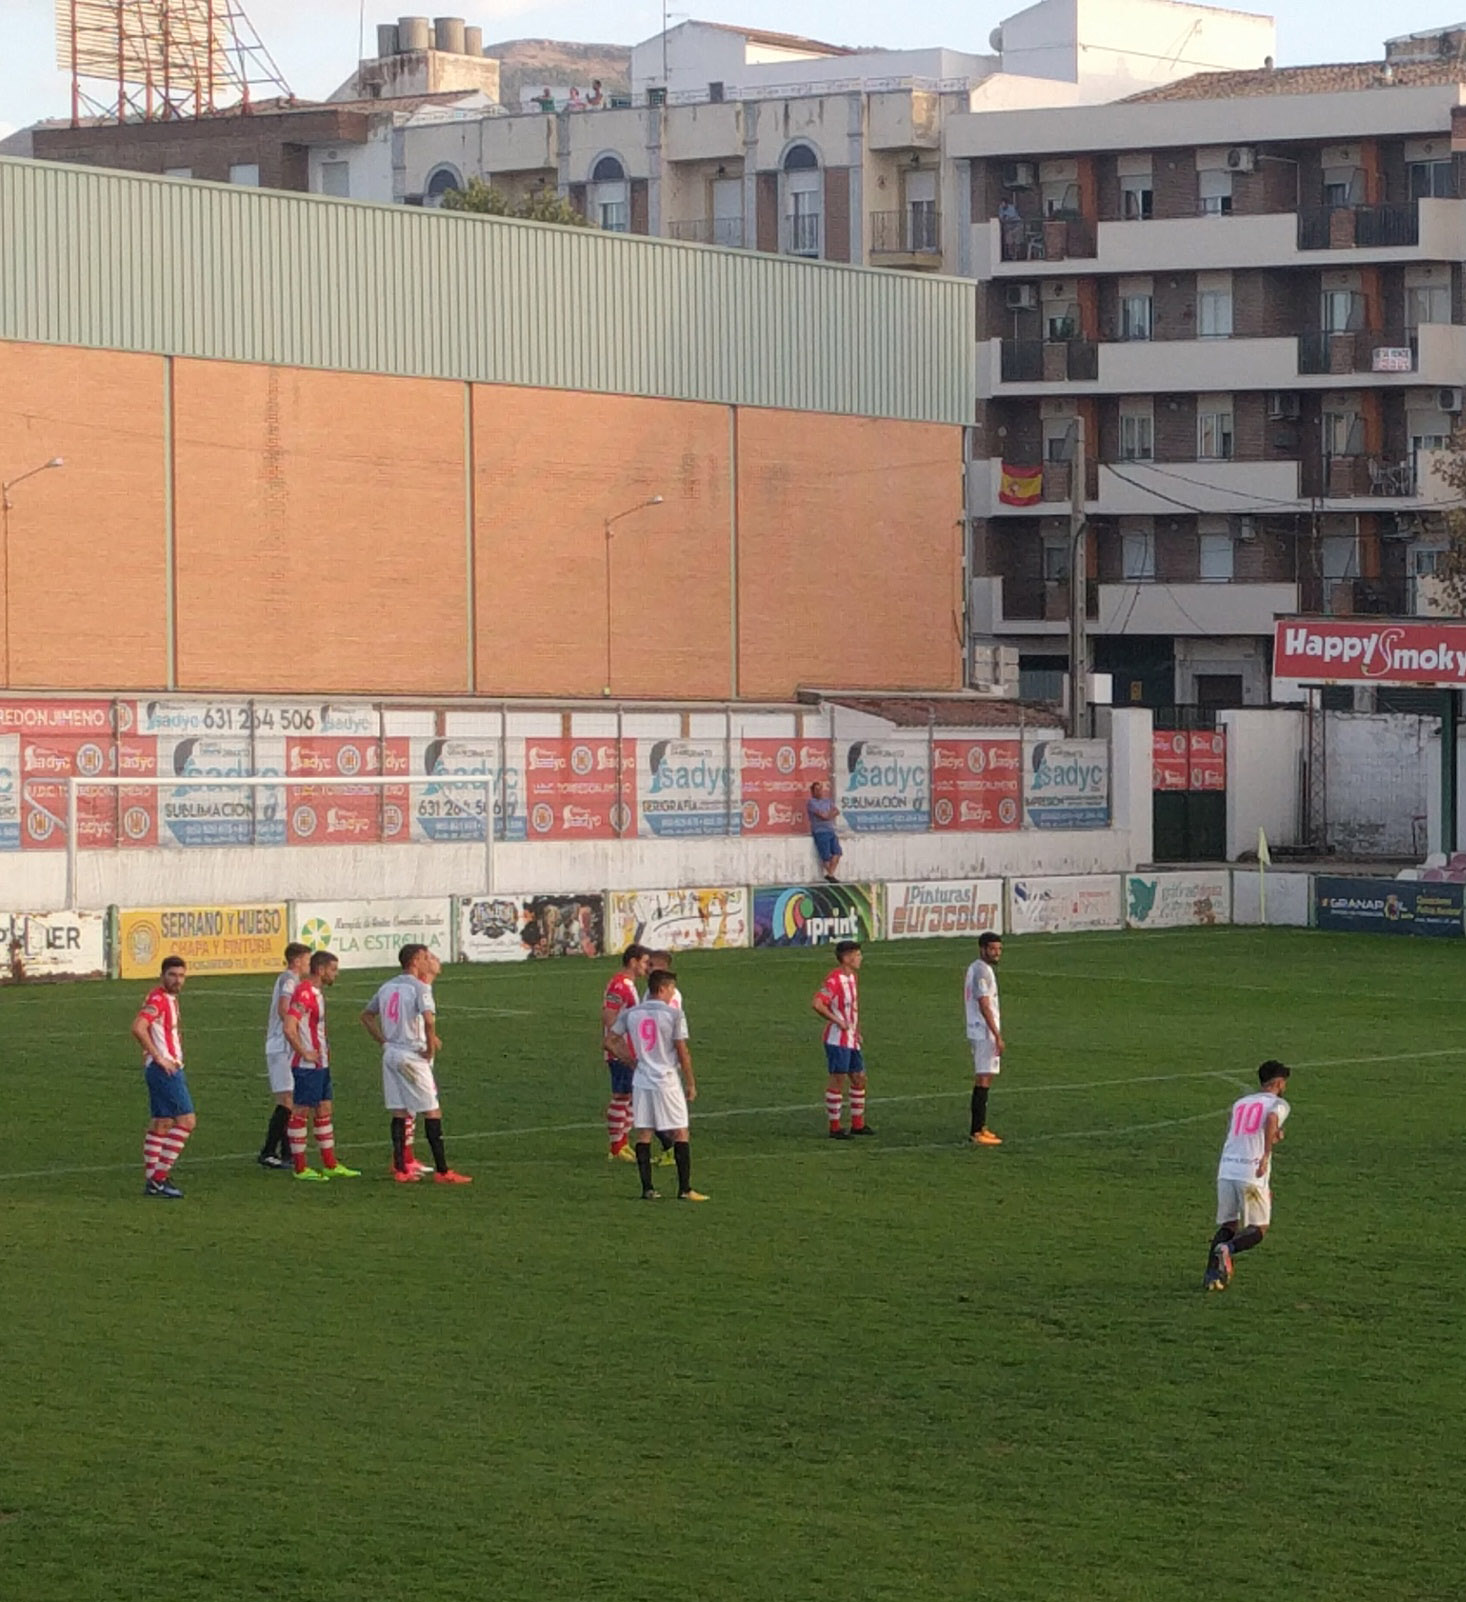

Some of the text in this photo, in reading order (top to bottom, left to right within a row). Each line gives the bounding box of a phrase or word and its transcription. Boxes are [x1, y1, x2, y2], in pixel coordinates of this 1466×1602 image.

[1285, 628, 1377, 663] Happy
[204, 708, 232, 729] 631
[280, 709, 315, 730] 506
[661, 759, 736, 795] sadyc
[858, 758, 925, 793] sadyc
[1041, 758, 1103, 792] sadyc
[418, 800, 440, 816] 631
[475, 800, 502, 816] 56
[909, 885, 971, 905] Pinturas
[161, 908, 281, 938] SERRANO Y HUESO
[638, 1018, 657, 1053] 9
[1233, 1101, 1265, 1137] 10
